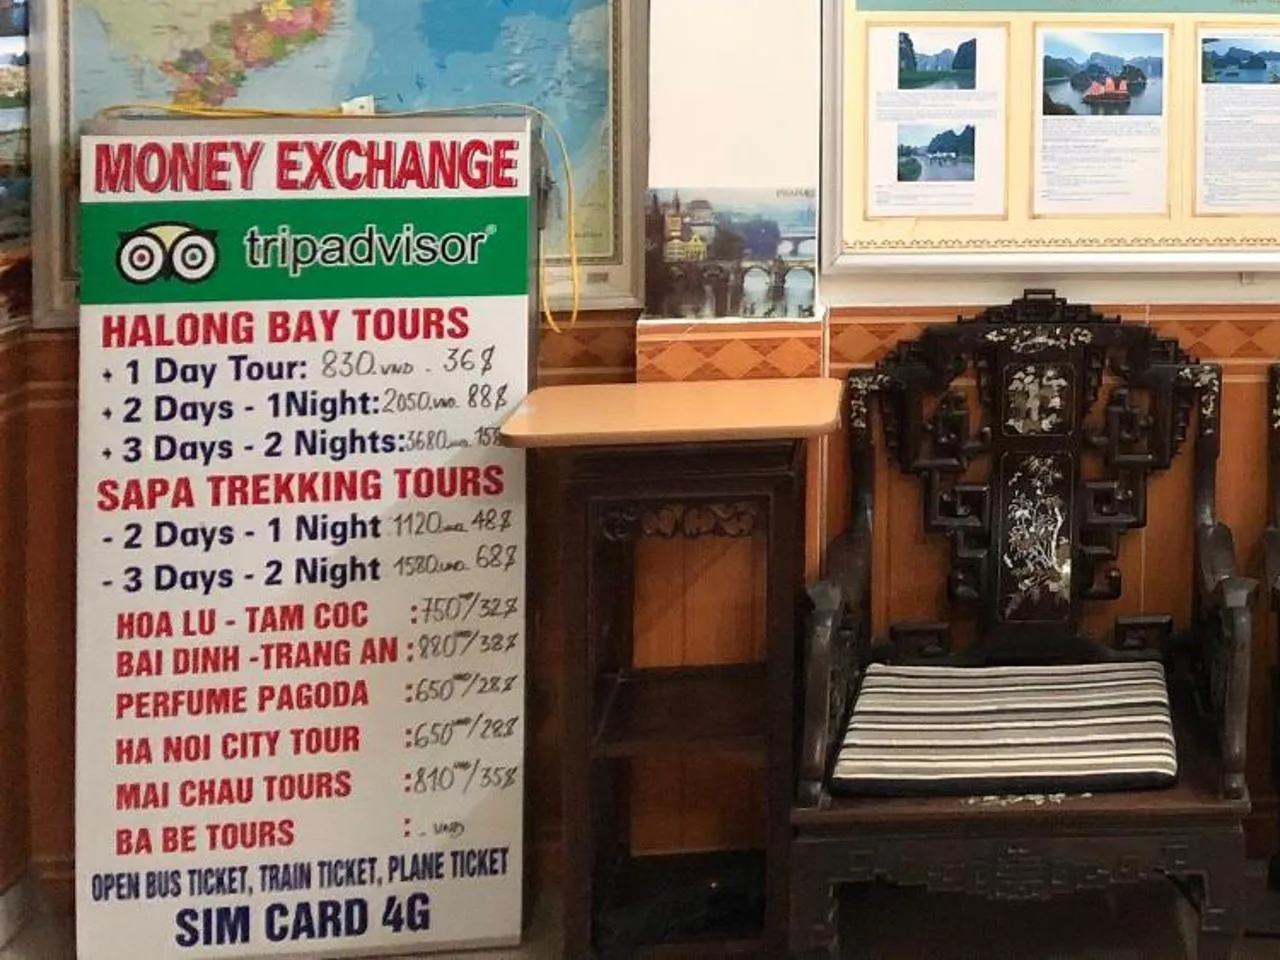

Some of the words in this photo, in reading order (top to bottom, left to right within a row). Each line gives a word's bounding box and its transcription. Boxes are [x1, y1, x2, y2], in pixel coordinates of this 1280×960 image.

[95, 139, 265, 194] MONEY
[276, 138, 519, 191] EXCHANGE
[102, 310, 255, 348] HALONG
[268, 309, 341, 344] BAY
[352, 306, 470, 342] TOURS
[126, 359, 140, 385] 1
[155, 356, 218, 389] Day
[227, 354, 308, 382] Tour:
[122, 396, 142, 424] 2
[155, 394, 234, 427] Days
[122, 436, 142, 463] 3
[155, 434, 233, 467] Days
[264, 431, 282, 458] 2
[295, 427, 405, 462] Nights:
[97, 476, 196, 512] SAPA
[206, 468, 382, 507] TREKKING
[394, 464, 505, 499] TOURS
[123, 522, 143, 549] 2
[155, 520, 234, 553] Days
[267, 516, 281, 543] 1
[296, 511, 382, 547] Night
[122, 565, 143, 592] 3
[155, 563, 233, 596] Days
[264, 559, 283, 586] 2
[295, 554, 381, 590] Night
[117, 609, 174, 640] HOA
[183, 607, 216, 637] LU
[245, 603, 305, 634] TAM
[314, 600, 369, 631] COC
[117, 649, 164, 678] BAI
[173, 645, 240, 675] DINH
[360, 635, 398, 665] AN
[116, 685, 248, 720] PERFUME
[258, 679, 370, 713] PAGODA
[116, 737, 153, 766] HA
[163, 733, 211, 764] NOI
[222, 729, 281, 761] CITY
[290, 724, 360, 756] TOUR
[116, 780, 169, 810] MAI
[180, 776, 254, 808] CHAU
[263, 769, 353, 802] TOURS
[116, 827, 153, 856] BA
[162, 825, 197, 853] BE
[206, 818, 295, 851] TOURS
[92, 871, 140, 901] OPEN
[146, 869, 182, 900] BUS
[187, 865, 254, 898] TICKET,
[259, 861, 312, 892] TRAIN
[317, 856, 383, 888] TICKET,
[388, 851, 445, 883] PLANE
[451, 846, 510, 879] TICKET
[175, 904, 251, 948] SIM
[265, 897, 369, 943] CARD
[381, 891, 431, 933] 4G
